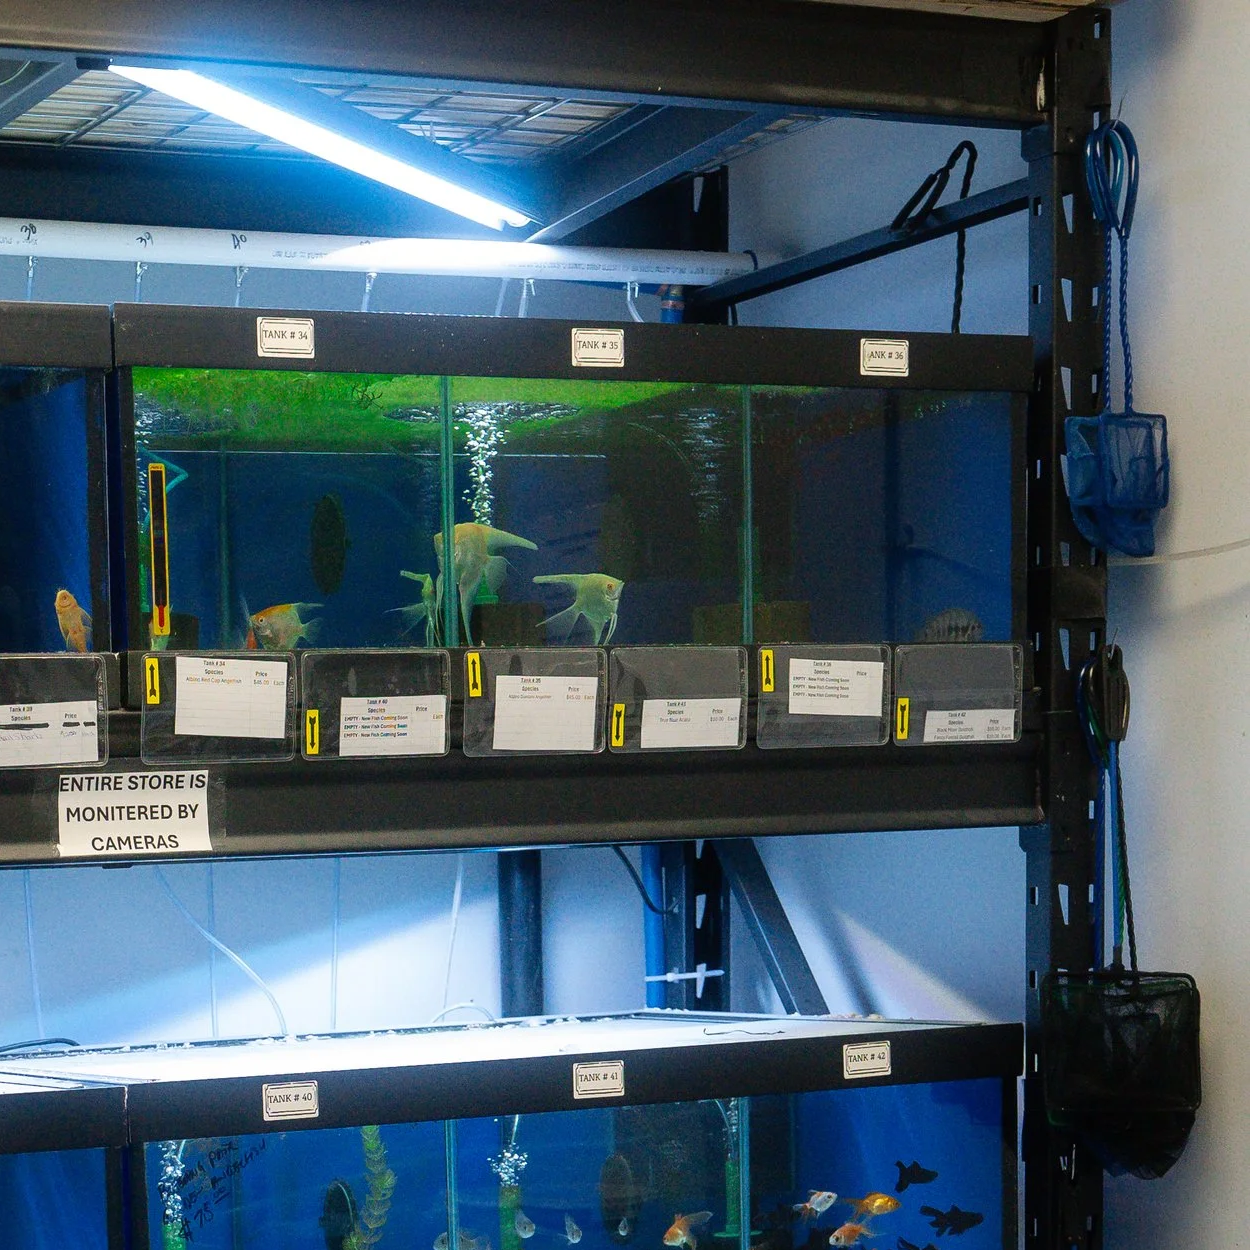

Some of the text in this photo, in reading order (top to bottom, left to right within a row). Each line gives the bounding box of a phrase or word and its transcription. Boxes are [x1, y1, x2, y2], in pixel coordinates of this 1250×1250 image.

[263, 330, 308, 340] TANK # 34
[577, 340, 599, 349] TANK
[868, 351, 886, 359] ANK
[60, 774, 206, 792] ENTIRE STORE IS
[66, 804, 199, 822] MONITERED BY
[91, 834, 179, 851] CAMERAS
[848, 1054, 868, 1062] TANK
[877, 1052, 886, 1060] 42
[579, 1073, 600, 1082] TANK
[610, 1072, 618, 1080] 41
[267, 1094, 291, 1104] TANK
[302, 1093, 312, 1101] 40
